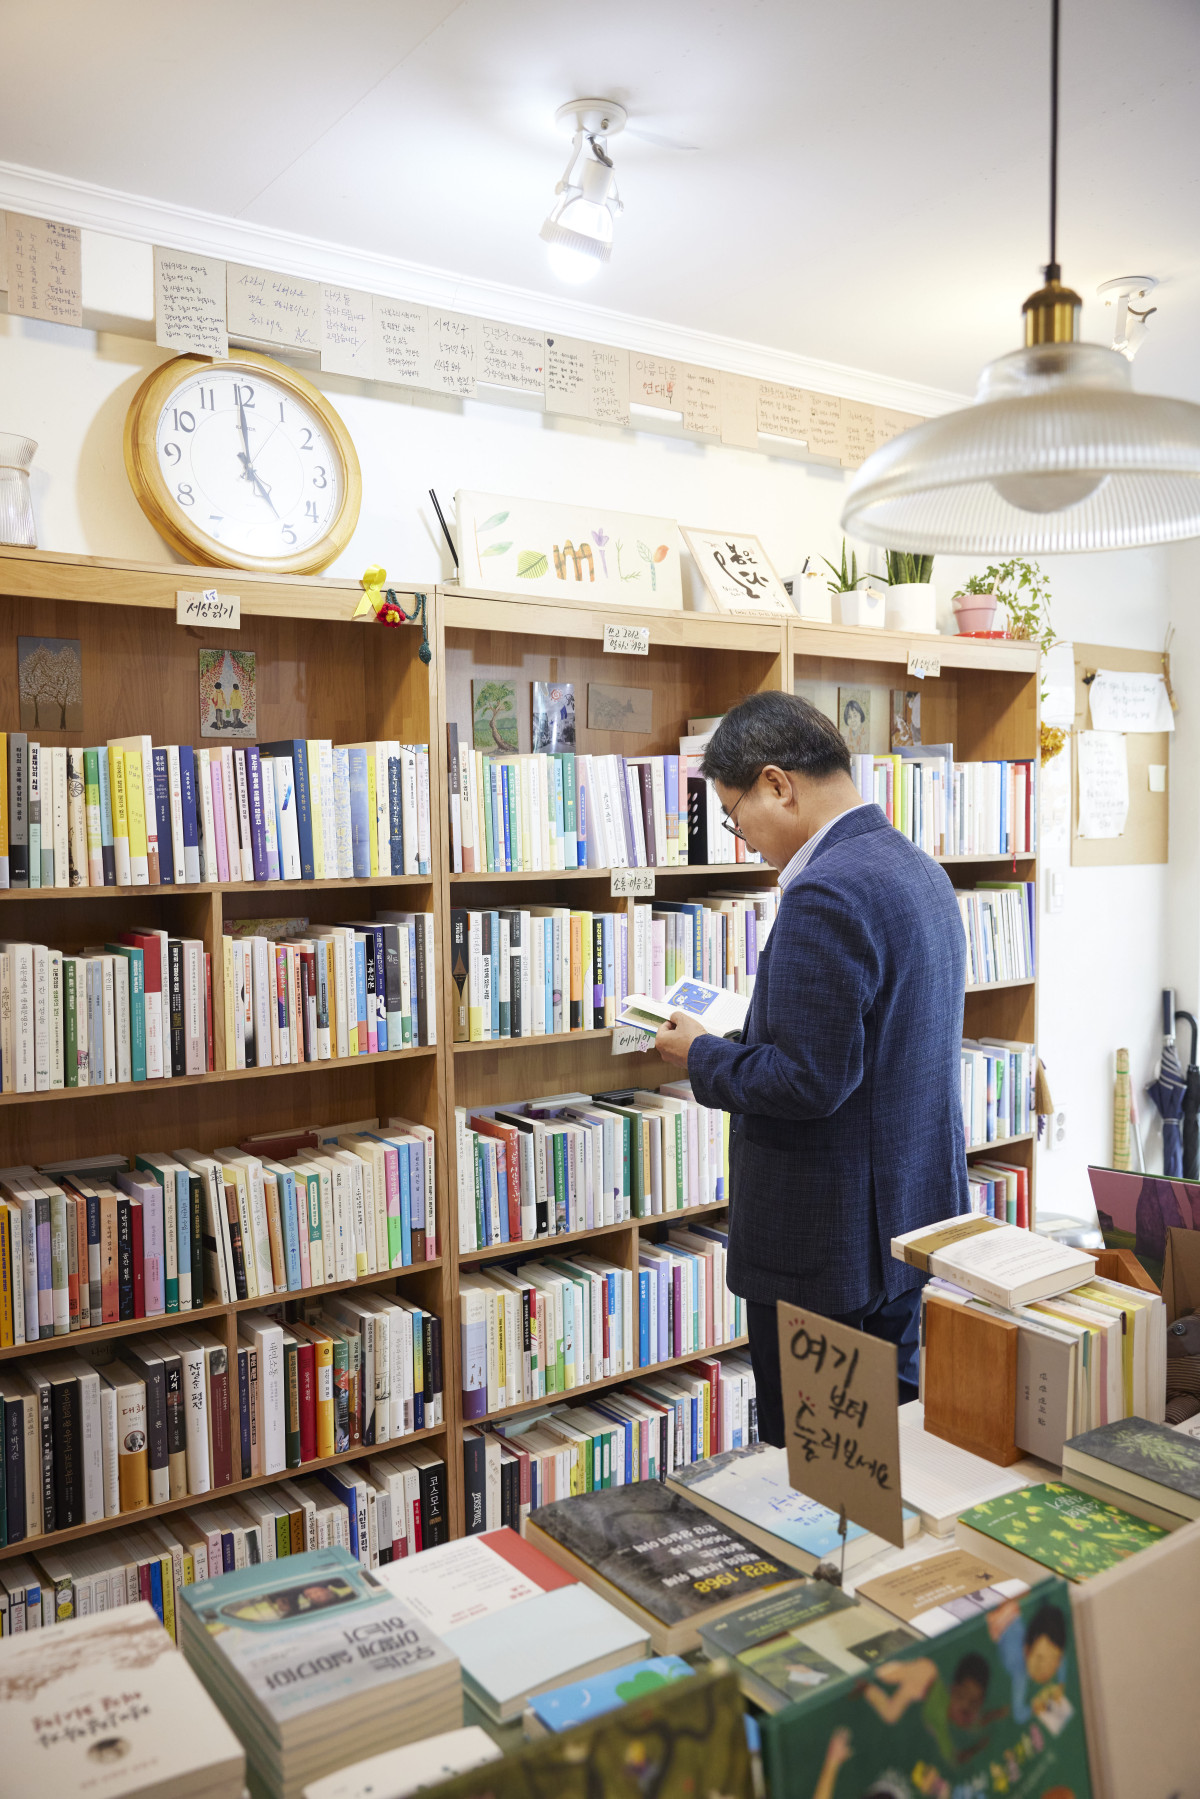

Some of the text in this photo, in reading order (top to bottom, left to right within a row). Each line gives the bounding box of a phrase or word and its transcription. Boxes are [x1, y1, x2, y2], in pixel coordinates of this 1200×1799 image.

[324, 289, 342, 302] 다섯
[636, 360, 677, 381] 아름다운
[199, 387, 216, 411] 11
[233, 383, 255, 408] 12
[643, 382, 666, 397] 연대
[173, 408, 196, 433] 10
[279, 402, 285, 423] 1
[300, 427, 313, 451] 2
[164, 442, 182, 466] 9
[312, 465, 327, 489] 3
[177, 483, 195, 507] 8
[304, 500, 319, 523] 4
[208, 515, 224, 538] 7
[281, 523, 298, 545] 5
[186, 601, 234, 619] 세상읽기
[251, 754, 259, 771] 참사는
[32, 779, 38, 791] 시대
[252, 772, 260, 789] 골목에
[16, 810, 22, 821] 공부
[254, 808, 262, 825] 않는다
[375, 932, 384, 975] 선량한 차별주의자
[366, 958, 375, 989] 가족각본
[483, 957, 490, 1000] 상자 밖에 있는 사람
[20, 957, 29, 1034] 근대문명에서 생태문명으로
[619, 1034, 651, 1046] 에세이
[122, 1252, 129, 1265] 공간
[123, 1267, 130, 1280] 침투
[268, 1342, 279, 1377] 내면소통
[791, 1328, 859, 1389] 여기
[170, 1371, 179, 1390] 강의
[291, 1379, 297, 1390] 공부
[122, 1403, 145, 1416] 대화
[828, 1385, 868, 1429] 부터
[429, 1475, 440, 1516] 코스모스
[358, 1509, 368, 1552] 시민의 물리학
[668, 1543, 693, 1556] 이후
[661, 1572, 690, 1588] 위해
[688, 1561, 724, 1578] 시대를
[693, 1561, 778, 1594] 한강, 1968
[370, 1646, 436, 1672] 우리는
